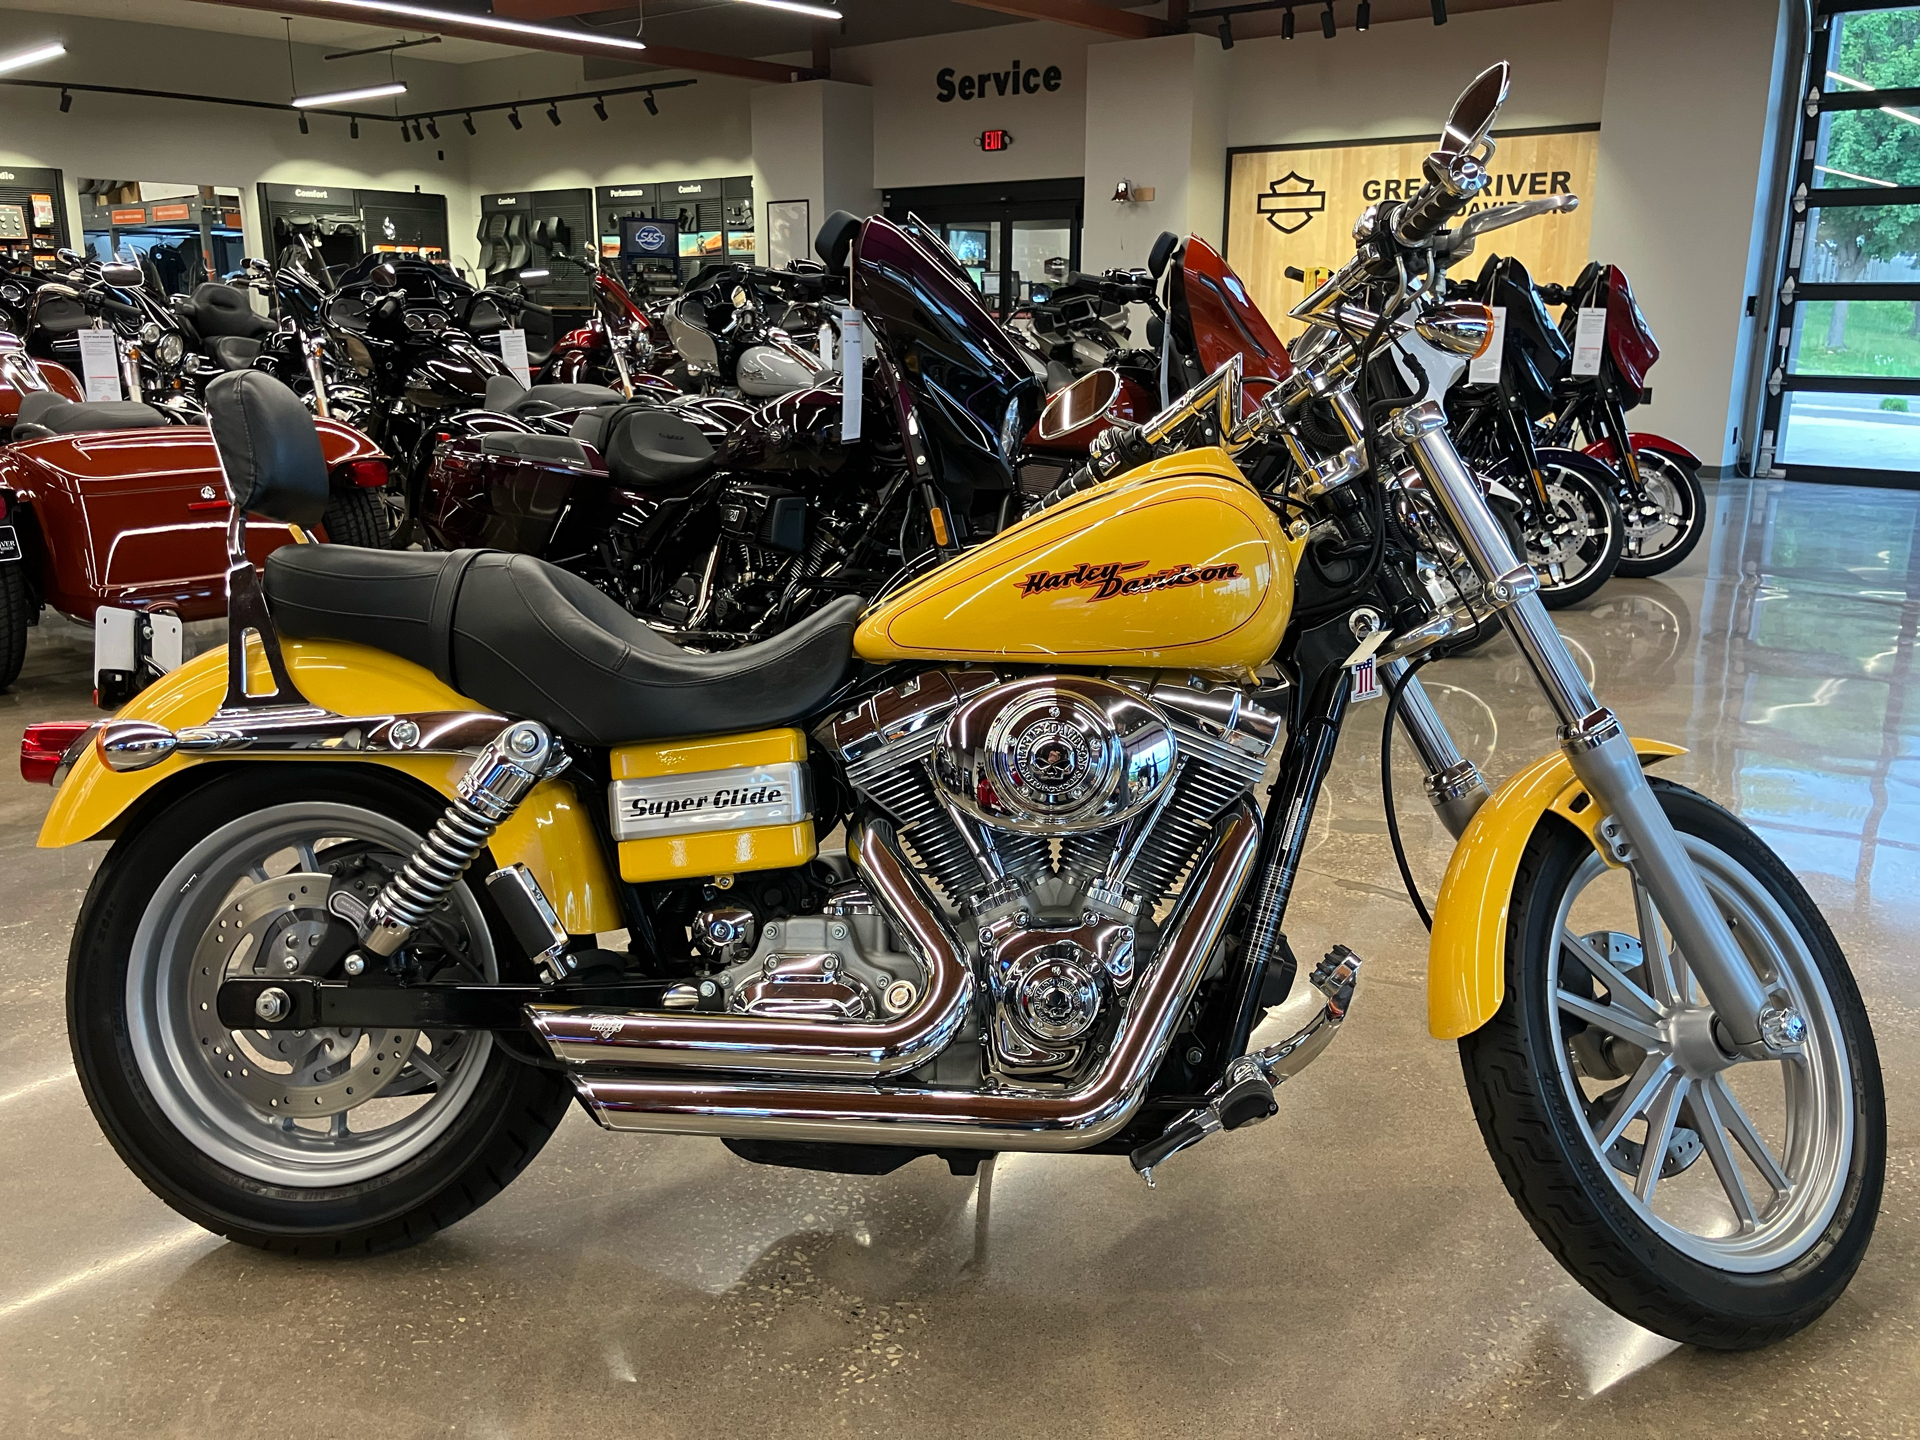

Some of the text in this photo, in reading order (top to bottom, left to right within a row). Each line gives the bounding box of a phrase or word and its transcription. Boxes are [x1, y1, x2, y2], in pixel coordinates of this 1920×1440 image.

[936, 60, 1062, 103] Service
[985, 131, 1003, 150] EXIT
[295, 188, 329, 199] Comfort
[610, 189, 643, 198] Performance
[678, 184, 702, 194] Comfort
[1362, 178, 1422, 201] GRE
[639, 232, 660, 243] S&S
[1019, 561, 1149, 595] Harley
[630, 786, 783, 818] Super Glide
